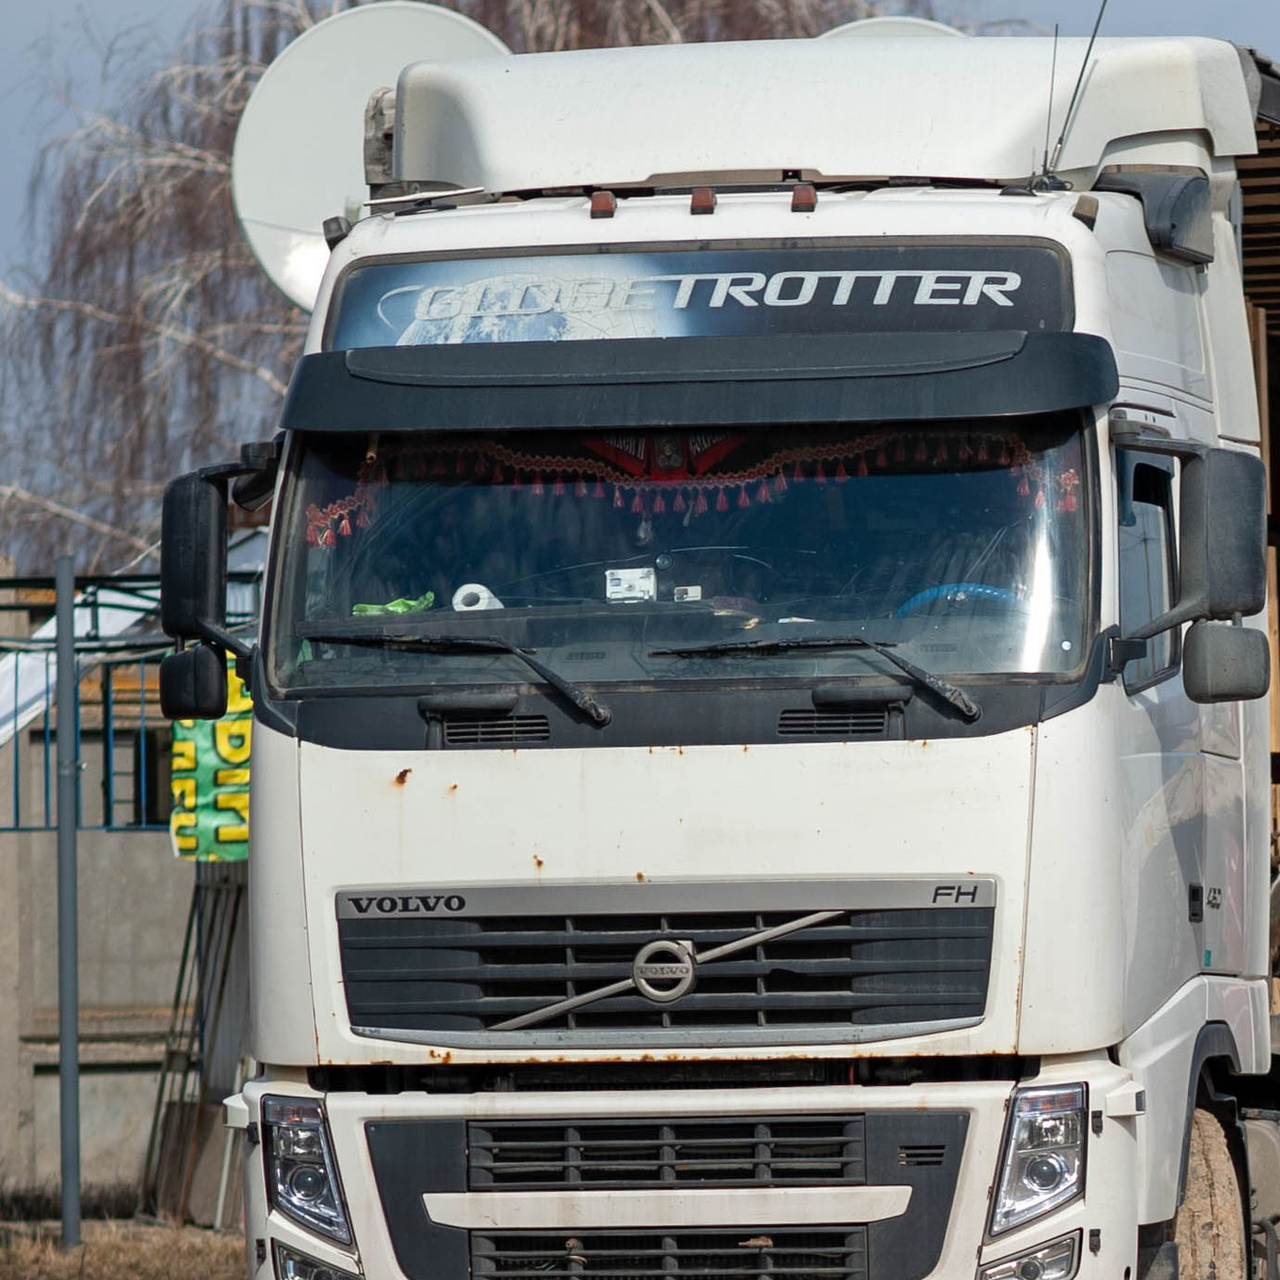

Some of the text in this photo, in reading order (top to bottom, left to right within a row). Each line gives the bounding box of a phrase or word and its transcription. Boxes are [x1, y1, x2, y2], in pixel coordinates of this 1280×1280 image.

[415, 270, 1022, 321] GLOBETROTTER
[932, 886, 978, 903] FH
[347, 895, 466, 913] VOLVO
